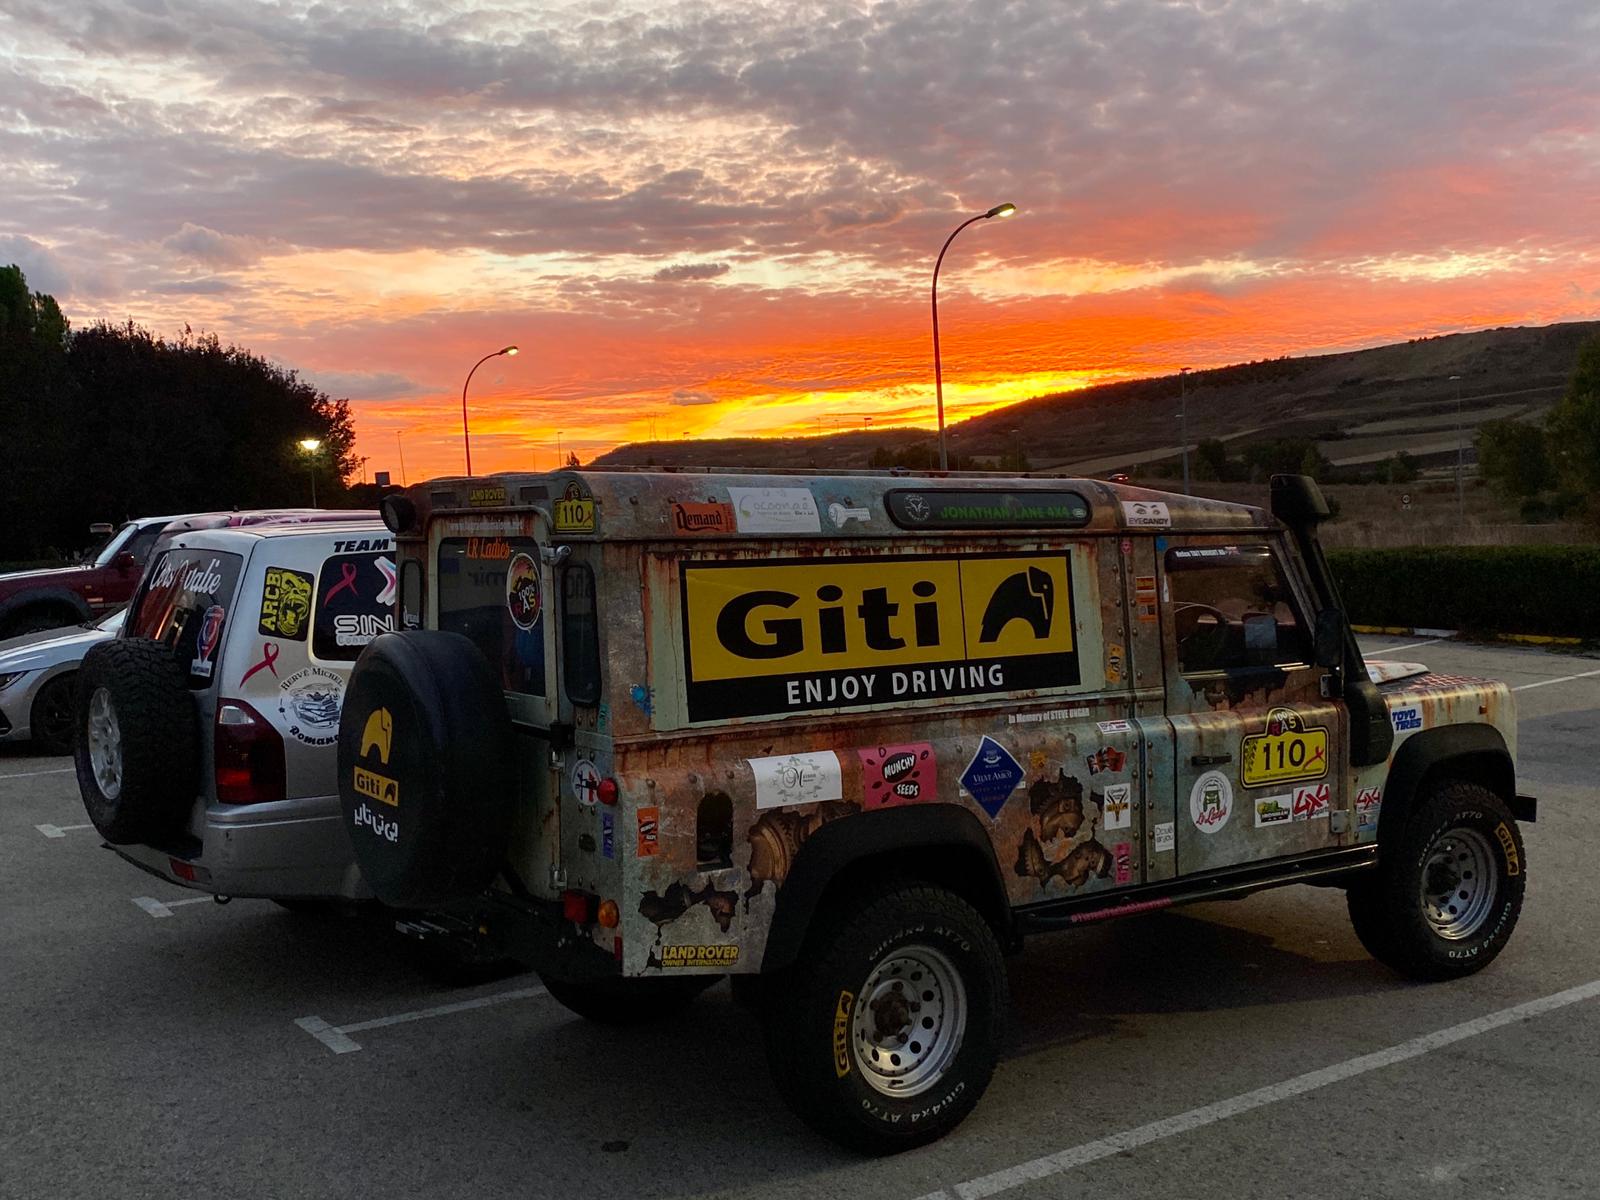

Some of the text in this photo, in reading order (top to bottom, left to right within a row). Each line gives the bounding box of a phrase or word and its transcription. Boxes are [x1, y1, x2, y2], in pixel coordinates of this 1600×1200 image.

[564, 505, 583, 523] 110
[941, 506, 1009, 519] JONATHAN
[1128, 517, 1168, 526] EYECANDY
[334, 539, 389, 553] TEAM
[480, 536, 511, 560] Ladies
[261, 572, 281, 632] ARCB
[717, 580, 941, 660] Giti
[786, 664, 1005, 705] ENJOY DRIVING
[1051, 709, 1069, 721] STEVE
[1392, 709, 1416, 721] TOYO
[1396, 718, 1422, 731] TIRES
[1264, 739, 1305, 770] 110
[884, 756, 917, 779] MUNCHY
[357, 773, 380, 796] Giti
[896, 784, 919, 797] SEEDS
[1498, 827, 1517, 860] Giti
[662, 945, 740, 960] LAND ROVER
[662, 959, 686, 967] OWNER
[836, 1020, 850, 1071] Giti
